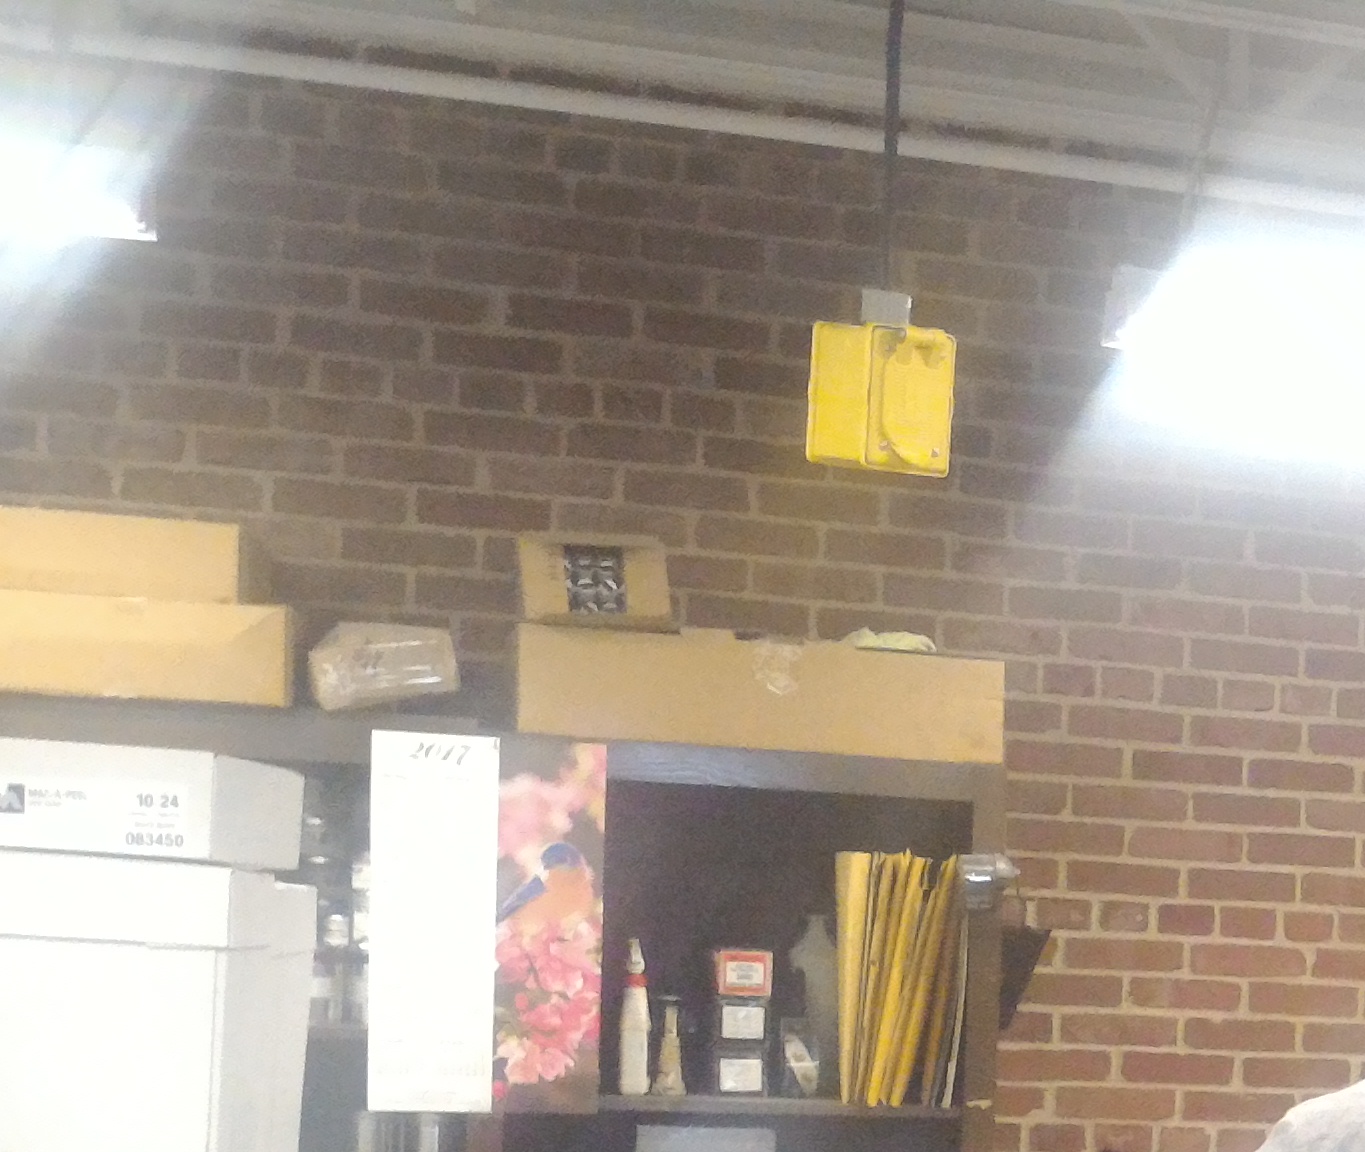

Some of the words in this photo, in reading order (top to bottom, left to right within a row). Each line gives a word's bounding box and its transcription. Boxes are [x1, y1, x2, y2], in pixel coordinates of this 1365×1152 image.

[409, 742, 471, 766] 2017
[136, 793, 154, 808] 10
[160, 793, 179, 808] 24
